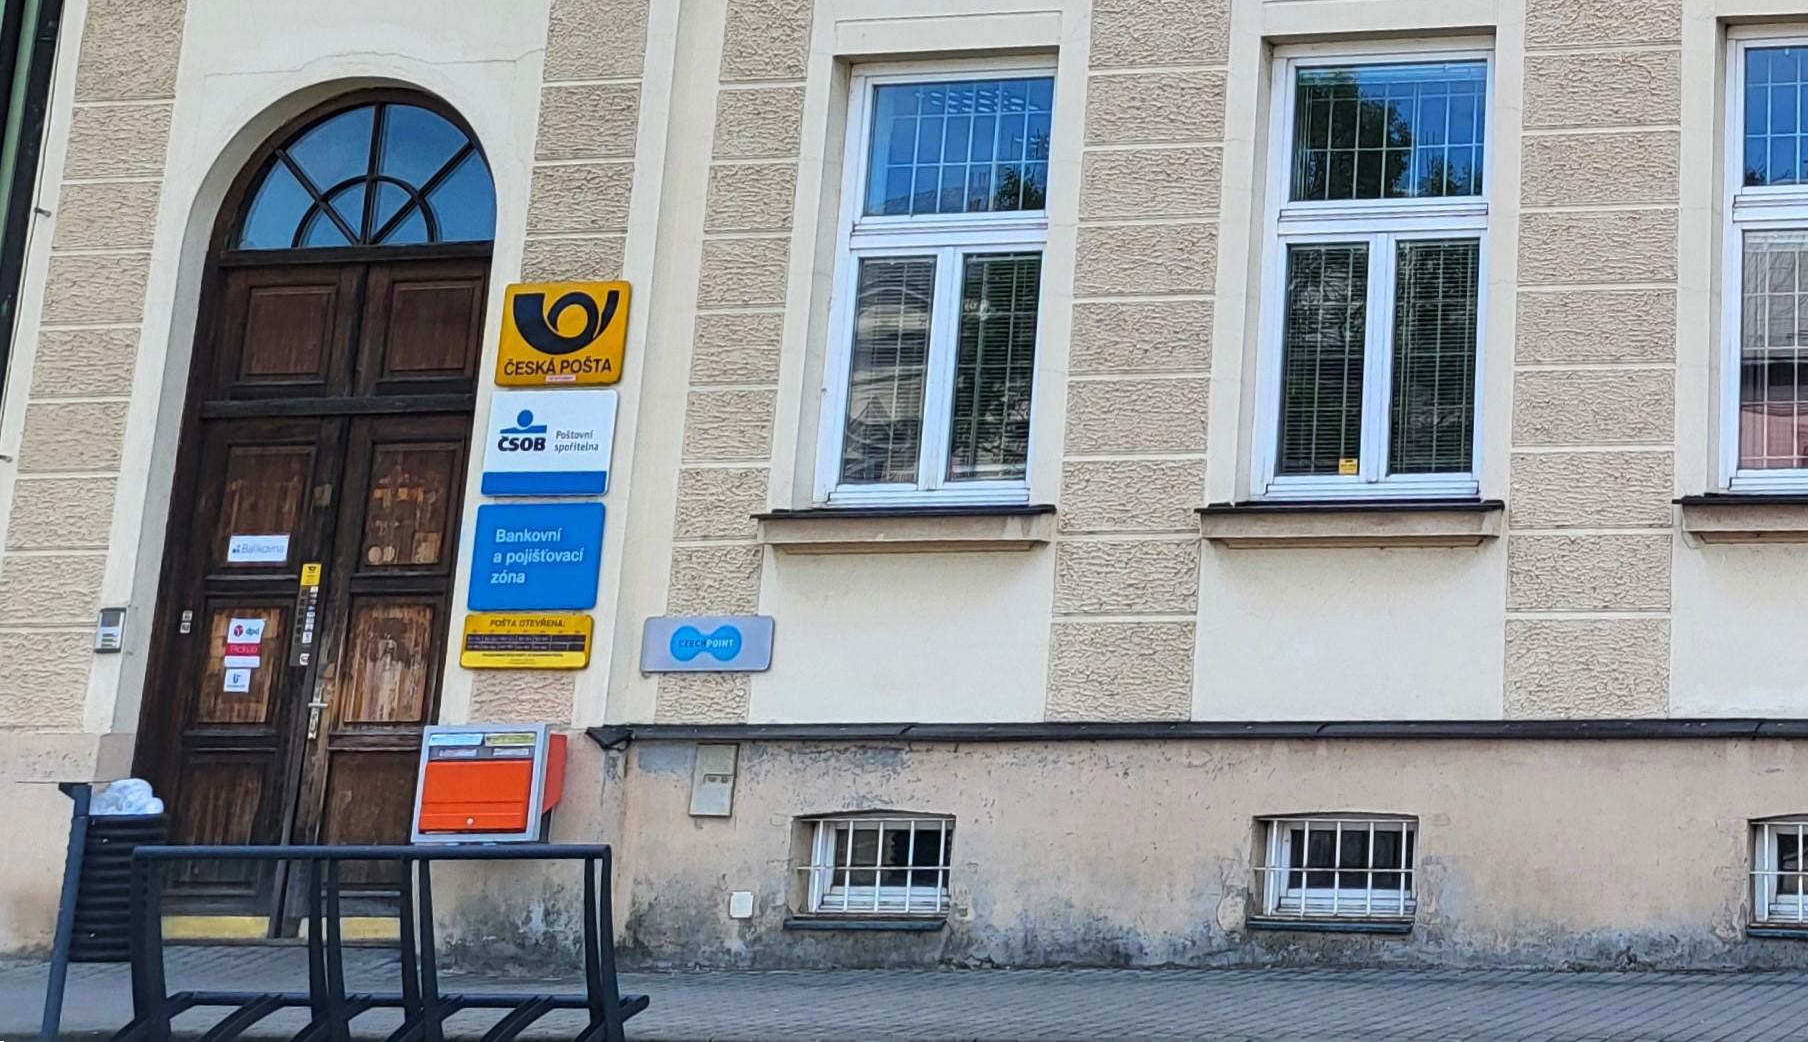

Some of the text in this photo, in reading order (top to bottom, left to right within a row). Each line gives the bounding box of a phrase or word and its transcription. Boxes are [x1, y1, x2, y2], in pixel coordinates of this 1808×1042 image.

[503, 356, 612, 376] ČESKÁ POŠTA
[555, 430, 594, 440] Poštovní
[497, 436, 546, 452] ČSOB
[554, 441, 599, 453] spořitelna
[495, 527, 562, 543] Bankovní
[493, 547, 584, 566] a pojišťovací
[490, 569, 525, 584] zóna
[489, 618, 517, 627] POŠTA
